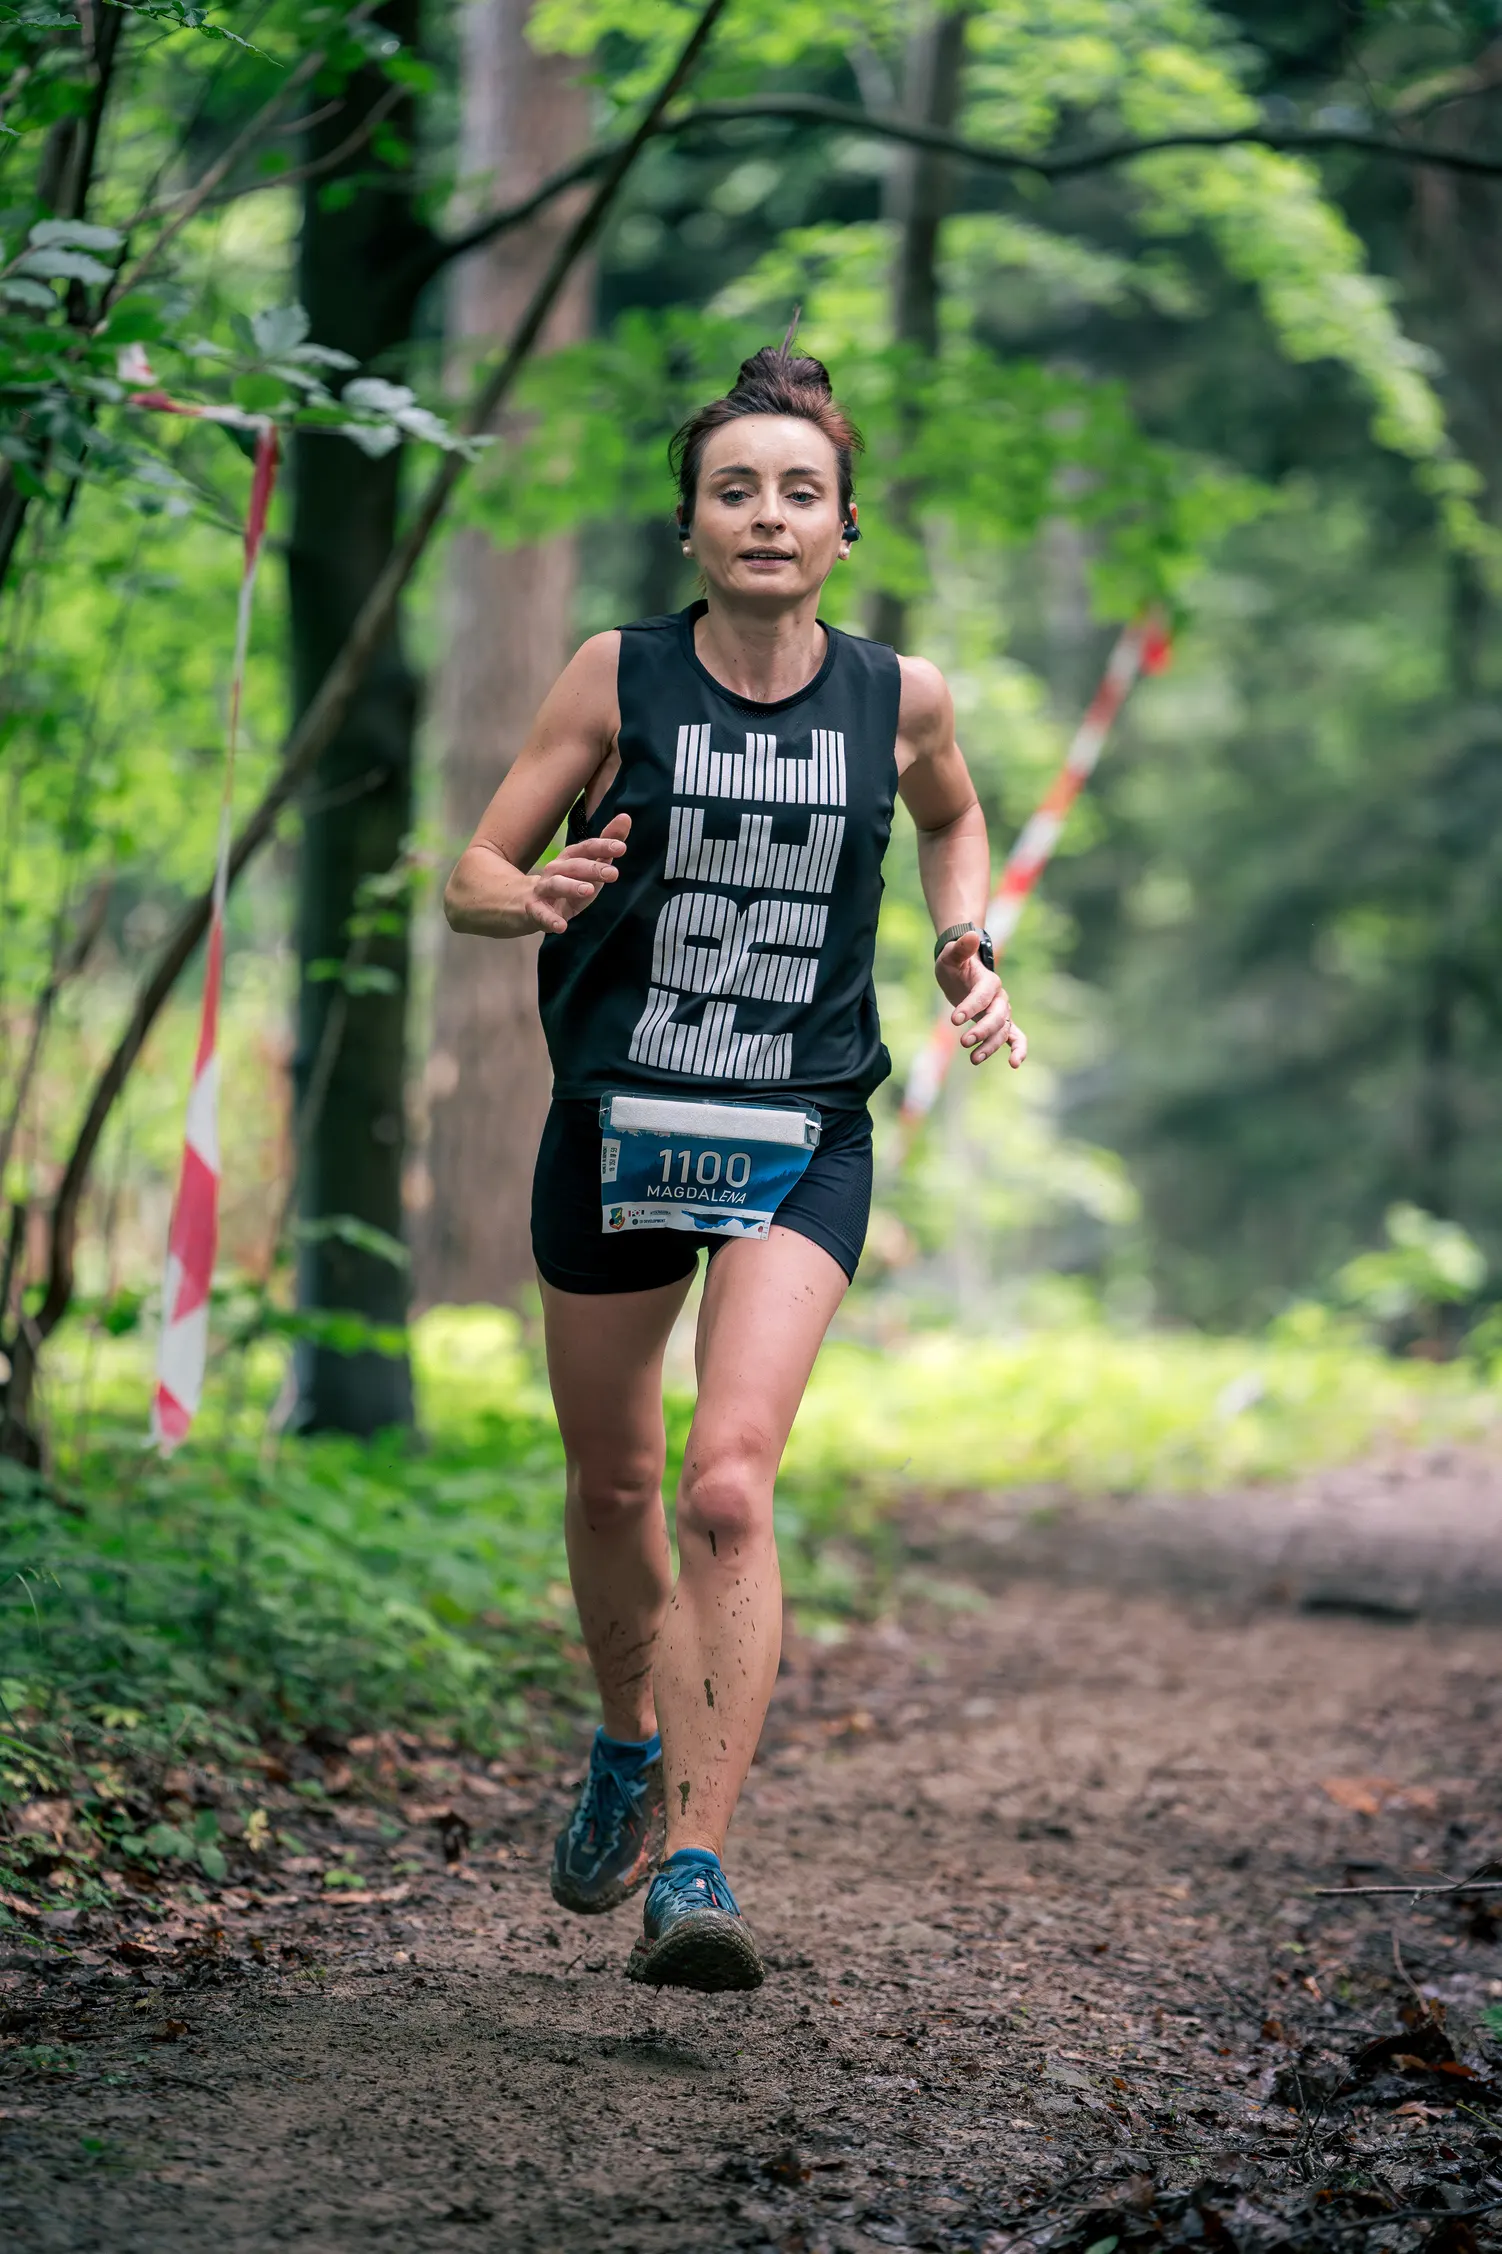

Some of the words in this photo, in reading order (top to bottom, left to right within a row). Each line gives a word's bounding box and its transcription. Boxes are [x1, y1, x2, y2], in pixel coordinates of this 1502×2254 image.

[628, 723, 847, 1080] FREE
[659, 1149, 752, 1188] 1100
[647, 1186, 747, 1204] MAGDALENA
